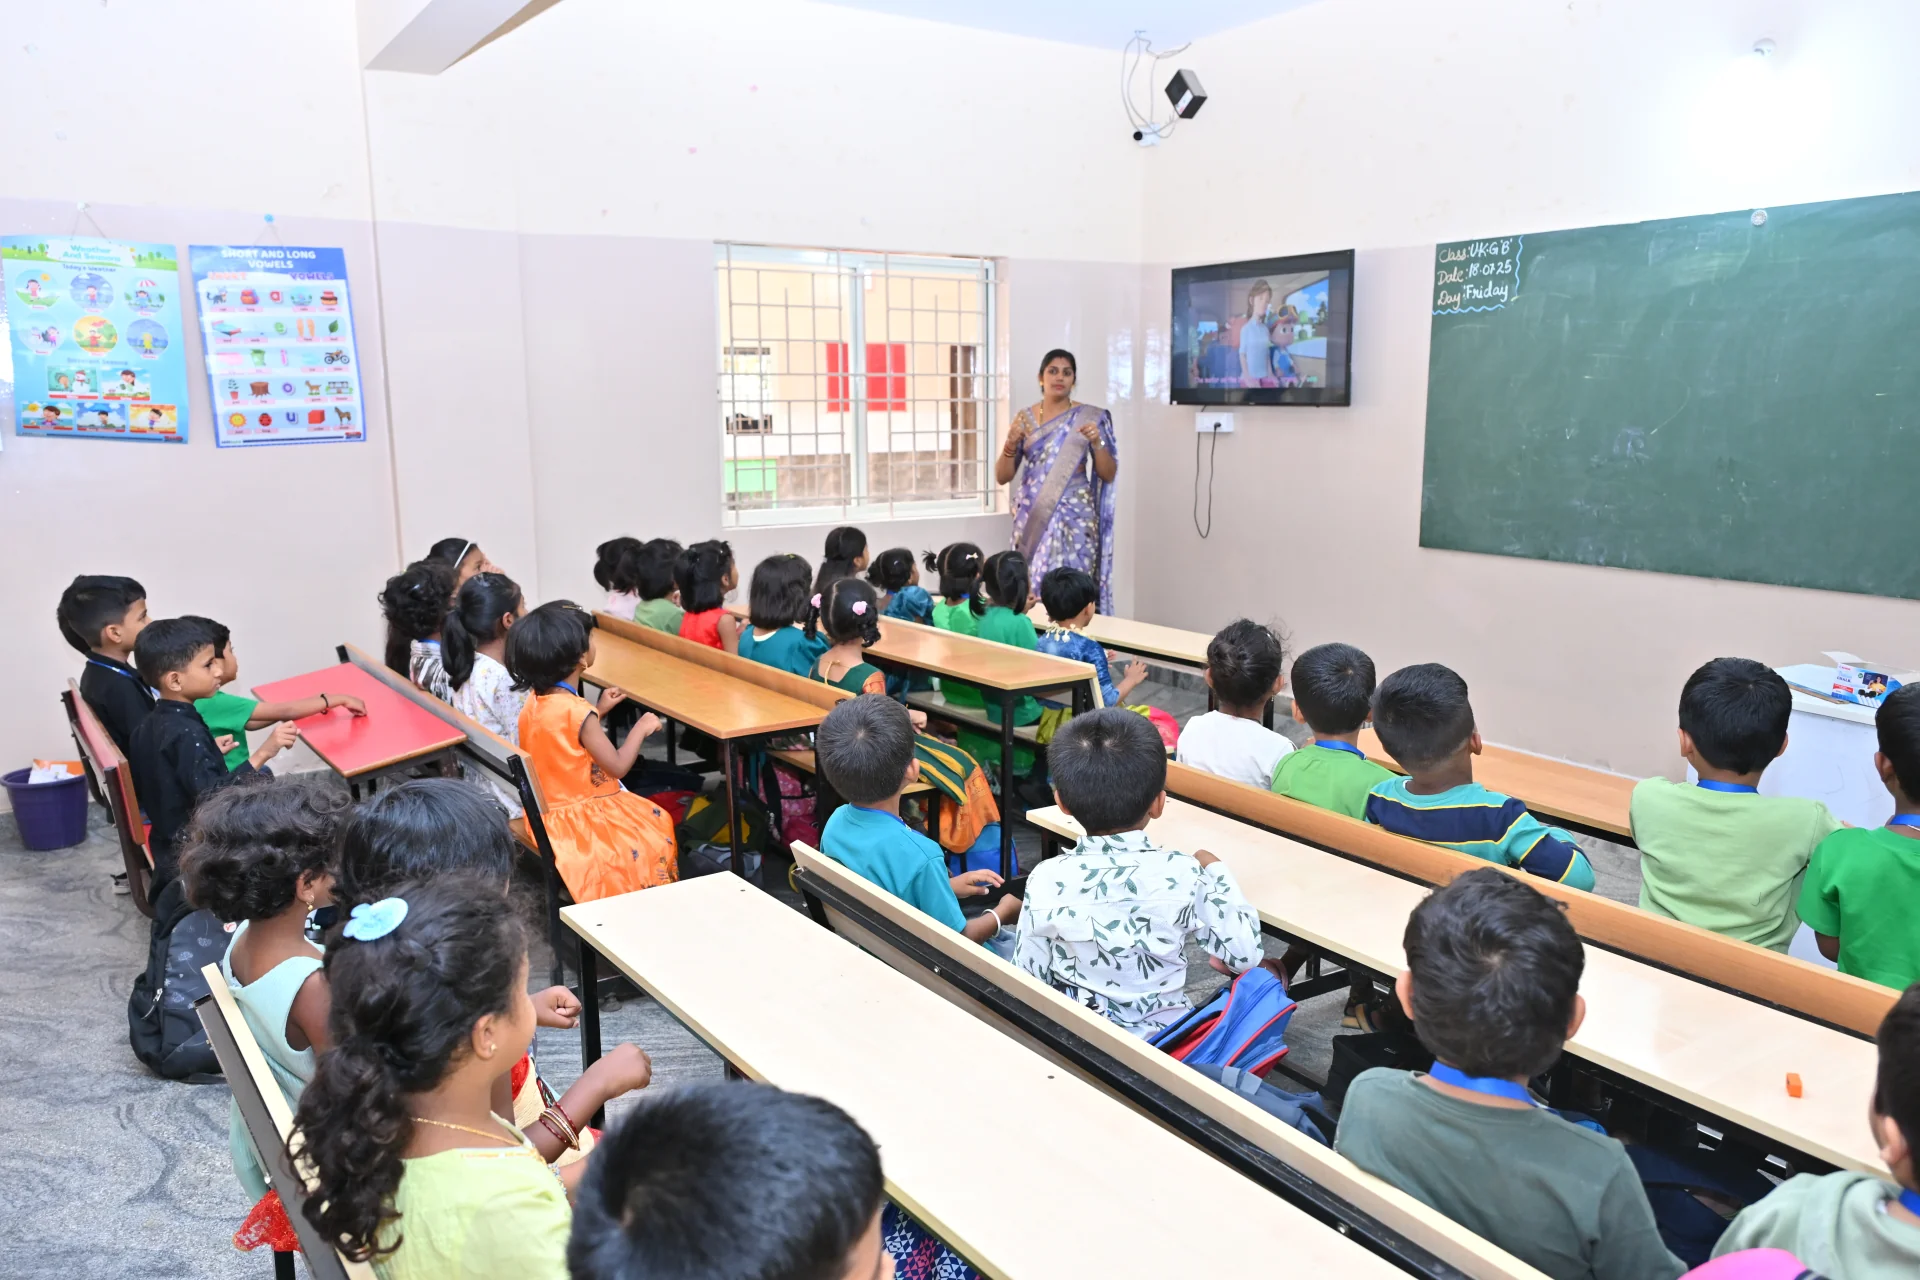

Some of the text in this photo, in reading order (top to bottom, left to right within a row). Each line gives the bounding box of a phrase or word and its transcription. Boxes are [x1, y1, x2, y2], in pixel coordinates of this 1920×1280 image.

[221, 249, 316, 259] SHORT AND LONG
[247, 260, 294, 269] VOWELS
[289, 272, 335, 281] VOWELS
[1466, 280, 1509, 302] Friday
